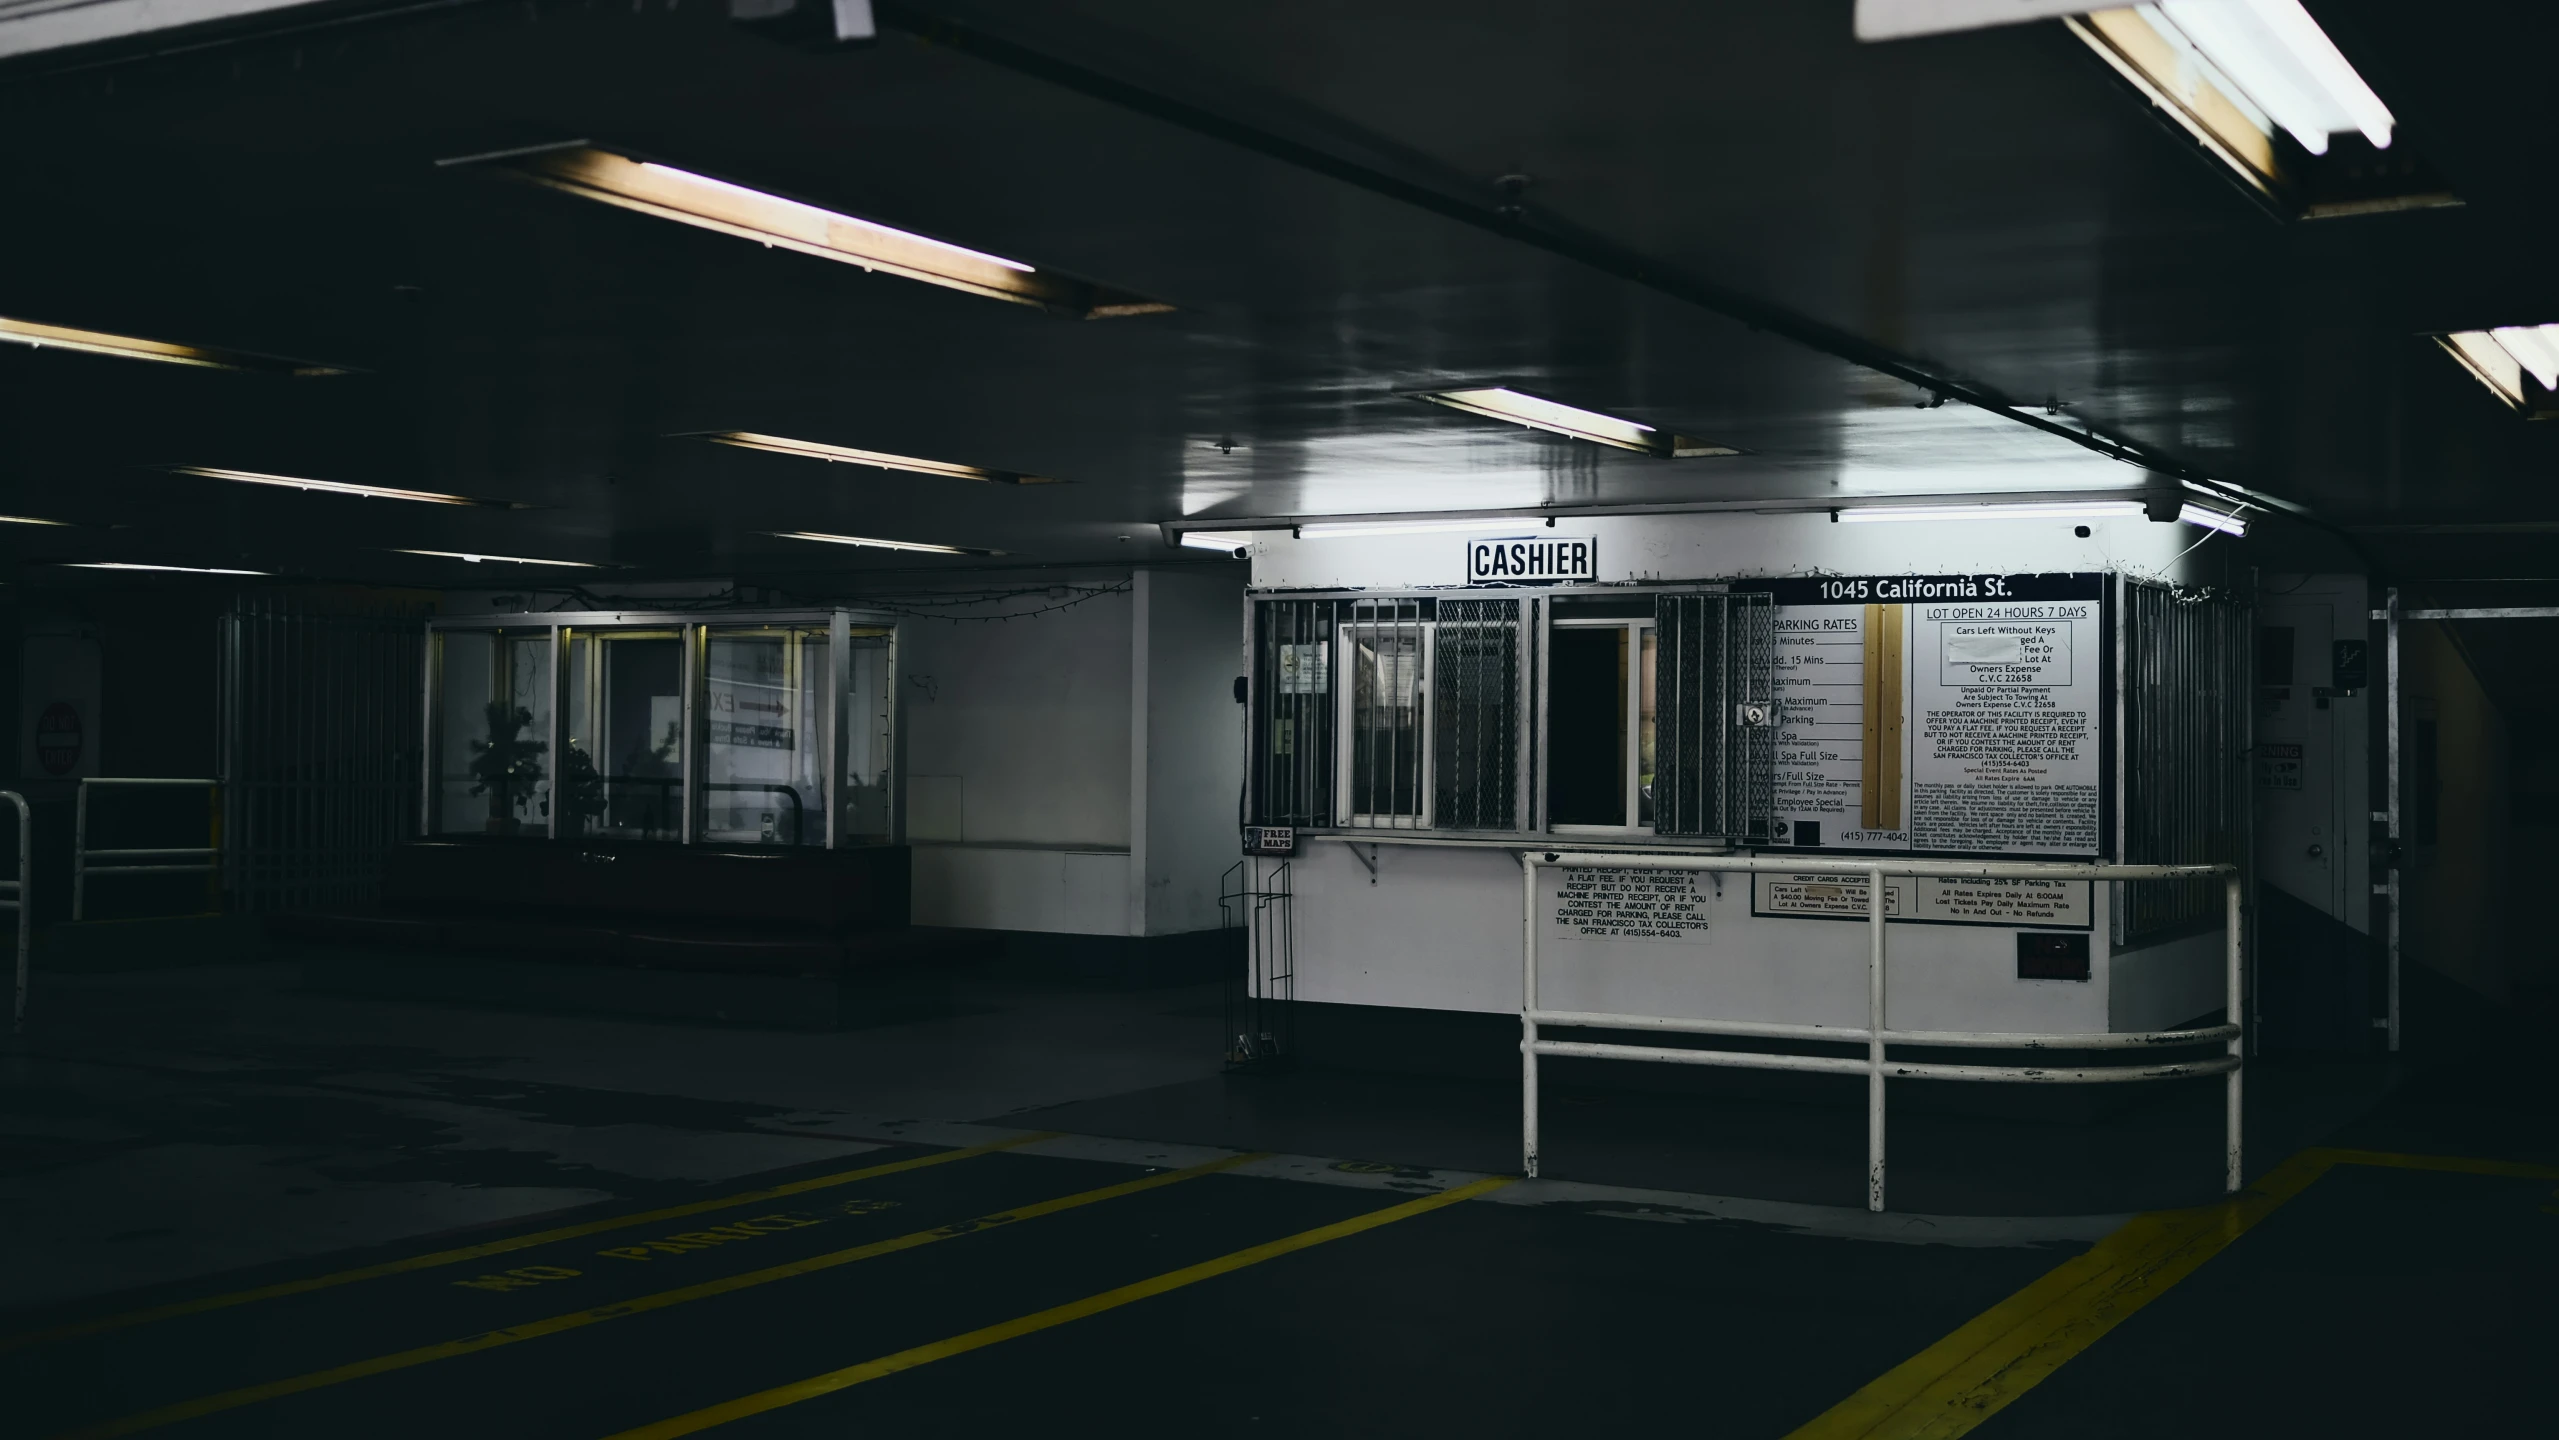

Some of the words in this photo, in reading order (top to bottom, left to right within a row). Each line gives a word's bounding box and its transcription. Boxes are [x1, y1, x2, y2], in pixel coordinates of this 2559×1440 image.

[1475, 543, 1587, 576] CASHIER
[1821, 581, 1868, 599] 1045
[1876, 578, 1977, 598] California
[1985, 577, 2012, 597] St.
[1927, 609, 1949, 619] LOT
[1952, 608, 1983, 618] OPEN
[1987, 608, 2001, 618] 24
[2004, 607, 2044, 618] HOURS
[2048, 607, 2054, 617] 7
[2058, 606, 2087, 617] DAYS
[1773, 619, 1819, 630] PARKING
[1824, 619, 1857, 630] RATES
[1957, 627, 1975, 635] Cars
[1978, 626, 1995, 634] Left
[1998, 626, 2032, 634] Without
[2036, 626, 2055, 635] Keys
[1779, 637, 1814, 645] Minutes
[1791, 656, 1801, 664] 15
[1804, 656, 1824, 664] Mins
[2025, 655, 2039, 663] Lot
[2041, 655, 2051, 663] At
[2005, 665, 2041, 674] Expense
[2005, 674, 2032, 682] 22658
[1961, 687, 1984, 695] Unpaid
[2021, 687, 2050, 695] Payment
[1784, 697, 1827, 705] Maximum
[1977, 694, 2003, 702] Subject
[2015, 694, 2038, 702] Towing
[1983, 701, 2011, 709] Expense
[43, 715, 55, 730] DO
[58, 715, 76, 730] NOT
[1781, 716, 1814, 726] Parking
[1781, 732, 1797, 741] Spa
[1781, 751, 1797, 761] Spa
[1800, 751, 1816, 760] Full
[1820, 751, 1838, 760] Size
[2261, 746, 2299, 757] RNING
[45, 749, 73, 765] ENTER
[2274, 776, 2281, 786] In
[2283, 776, 2298, 786] Use
[1777, 798, 1814, 808] Employee
[1815, 798, 1843, 808] Special
[1264, 830, 1290, 838] FREE
[1841, 831, 1863, 842] (415)
[1867, 832, 1907, 841] 777-4042
[1619, 875, 1626, 883] IF
[1649, 876, 1685, 884] REQUEST
[1557, 892, 1589, 900] MACHINE
[1593, 892, 1624, 901] PRINTED
[1628, 893, 1660, 902] RECEIPT,
[1664, 894, 1675, 902] OR
[1690, 895, 1706, 903] YOU
[1977, 891, 2002, 899] Expires
[2006, 891, 2022, 899] Daily
[1997, 900, 2013, 908] Daily
[1558, 909, 1593, 917] CHARGED
[1597, 910, 1612, 918] FOR
[1616, 911, 1649, 919] PARKING,
[1653, 912, 1682, 920] PLEASE
[1686, 913, 1706, 921] CALL
[1556, 917, 1569, 925] THE
[1573, 918, 1588, 926] SAN
[1592, 918, 1635, 927] FRANCISCO
[1638, 920, 1652, 928] TAX
[1656, 921, 1708, 930] COLLECTOR'S
[1580, 927, 1606, 935] OFFICE
[1623, 928, 1682, 938] (415)554-6403.
[449, 1264, 584, 1292] NO
